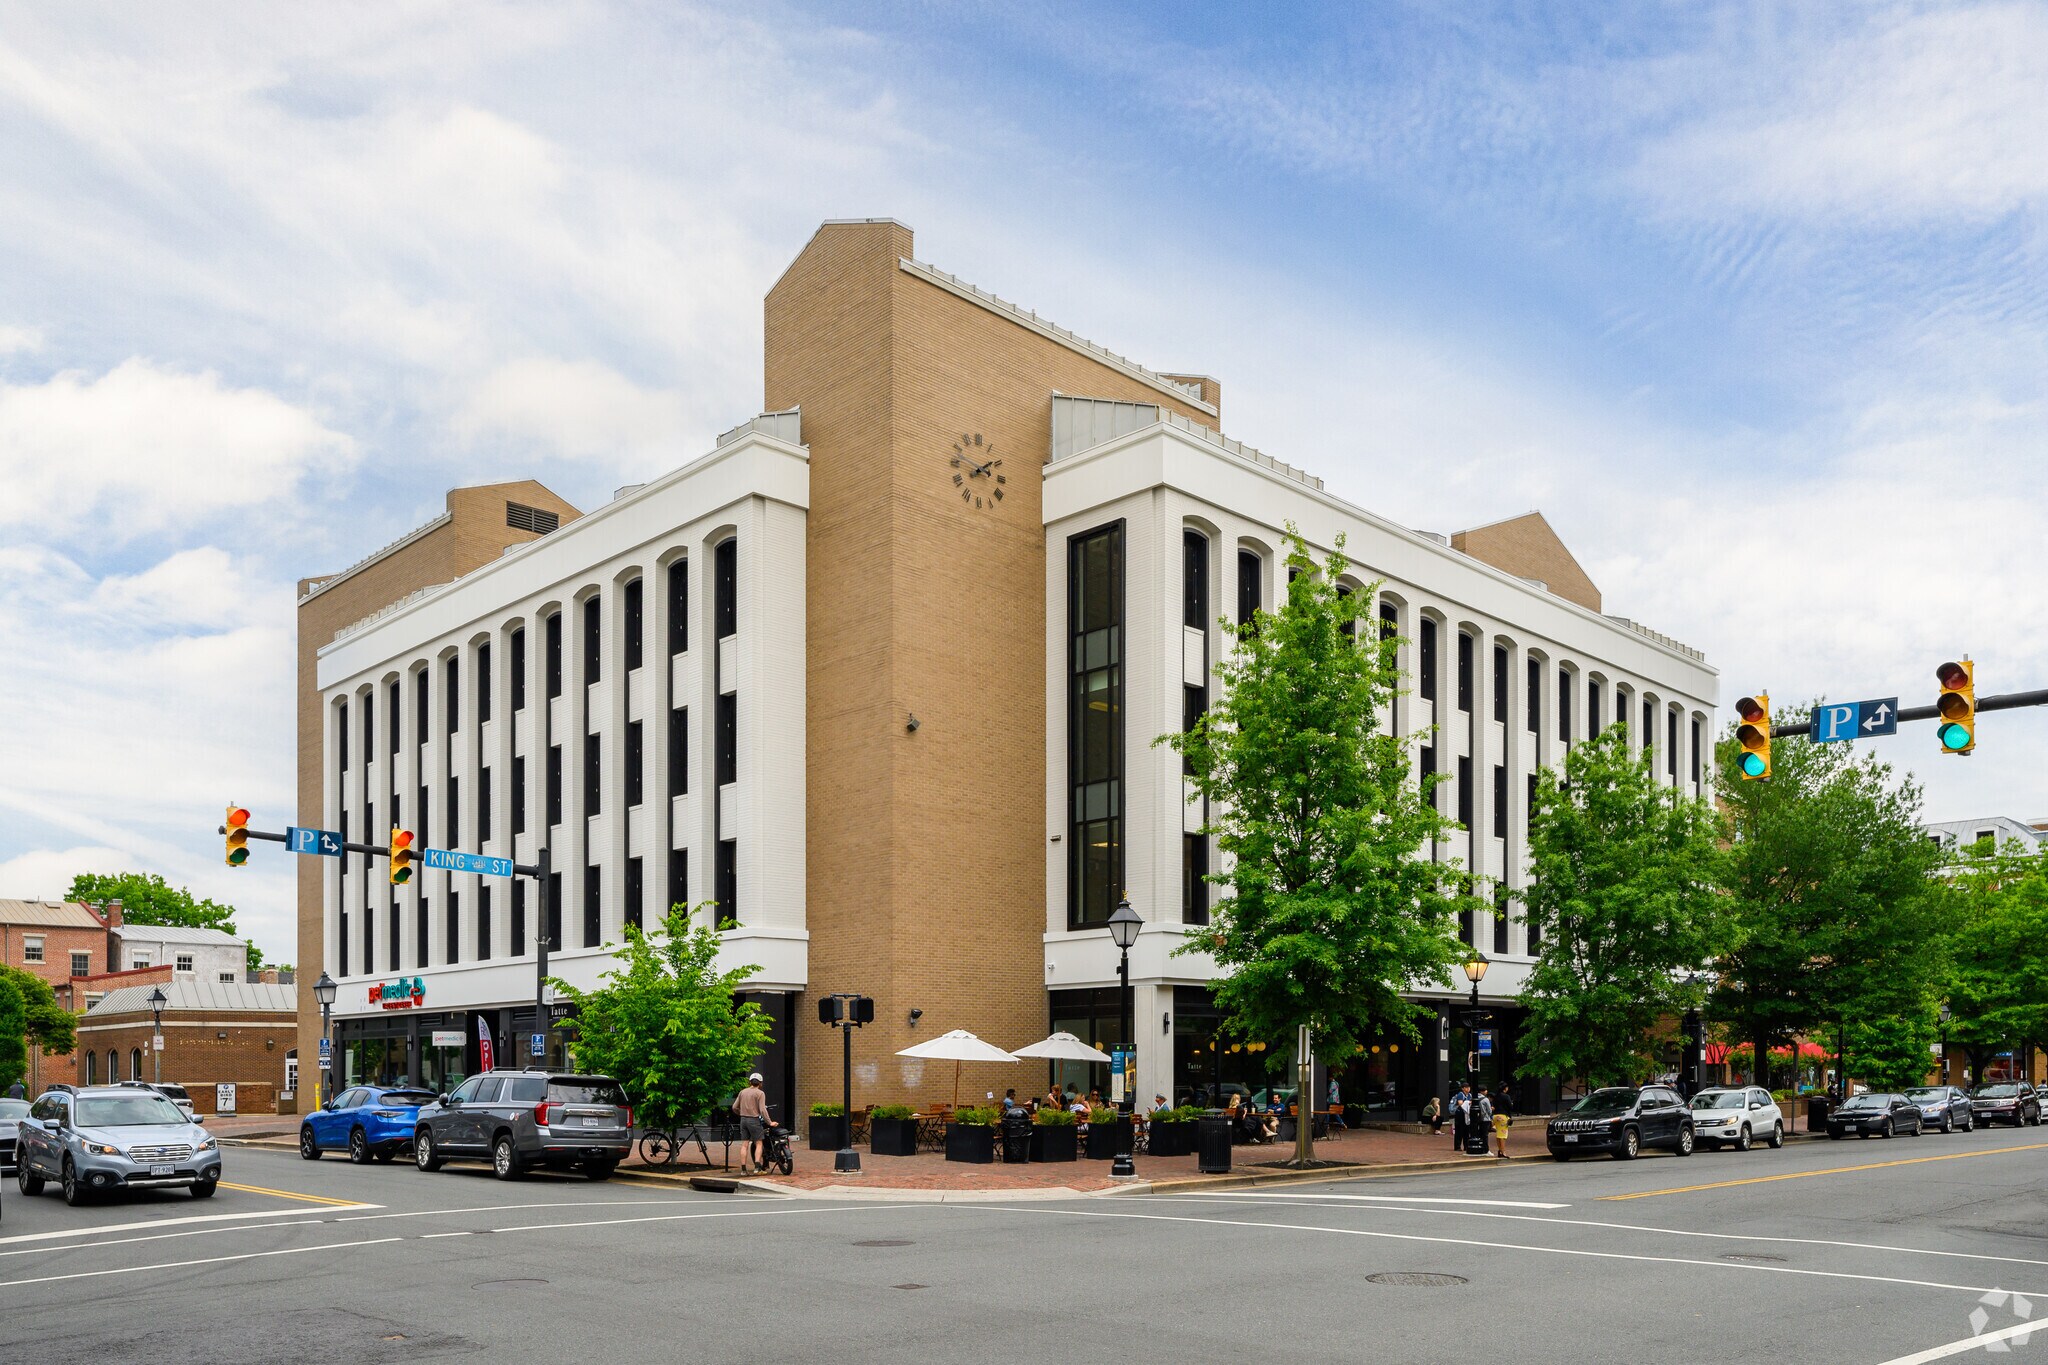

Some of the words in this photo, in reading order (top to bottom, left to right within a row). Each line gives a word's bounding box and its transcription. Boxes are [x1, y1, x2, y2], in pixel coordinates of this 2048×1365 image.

[1825, 706, 1852, 739] P
[296, 830, 314, 851] P
[430, 851, 465, 869] KING
[492, 859, 508, 874] ST
[551, 1006, 568, 1016] Tatte
[1187, 1062, 1202, 1070] Tatte
